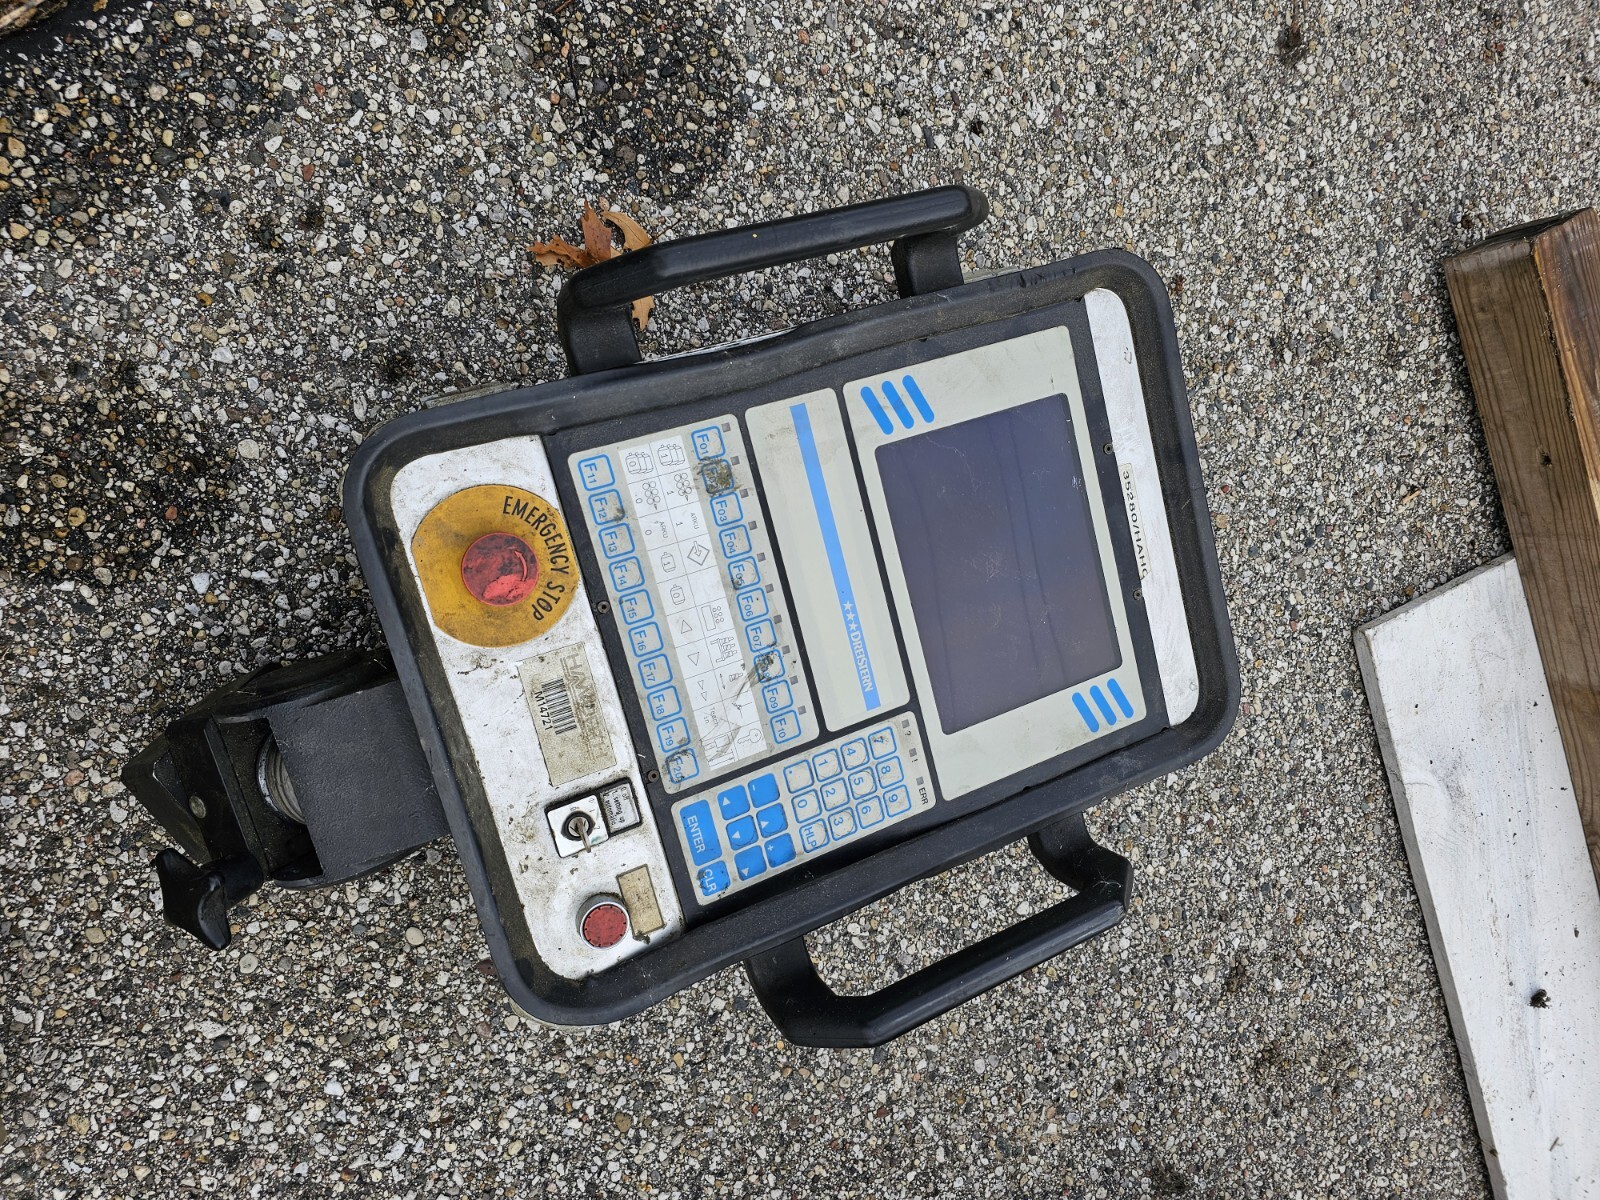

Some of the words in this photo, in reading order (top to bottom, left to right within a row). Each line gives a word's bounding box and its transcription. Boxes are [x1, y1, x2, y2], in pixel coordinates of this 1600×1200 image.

[696, 432, 709, 456] F01
[584, 462, 597, 484] F11
[594, 496, 607, 519] F12
[714, 499, 727, 522] F03
[658, 520, 668, 539] ARKU
[689, 511, 699, 530] ARKU
[501, 495, 570, 574] EMERGENCY
[604, 530, 617, 553] F13
[723, 531, 736, 554] F04
[614, 563, 627, 586] F14
[732, 563, 745, 586] F05
[531, 580, 565, 620] STOP
[624, 596, 637, 619] F15
[741, 595, 753, 617] F06
[633, 629, 646, 651] F16
[749, 626, 762, 648] F07
[642, 661, 655, 683] F17
[849, 630, 874, 692] DREISTERN
[652, 693, 665, 715] F18
[766, 687, 778, 709] F09
[533, 690, 553, 731] M14721
[661, 725, 674, 747] F19
[774, 717, 786, 739] F10
[918, 787, 929, 805] ERR
[686, 814, 706, 854] ENTER
[803, 826, 817, 848] HLP
[701, 867, 717, 892] CLR
